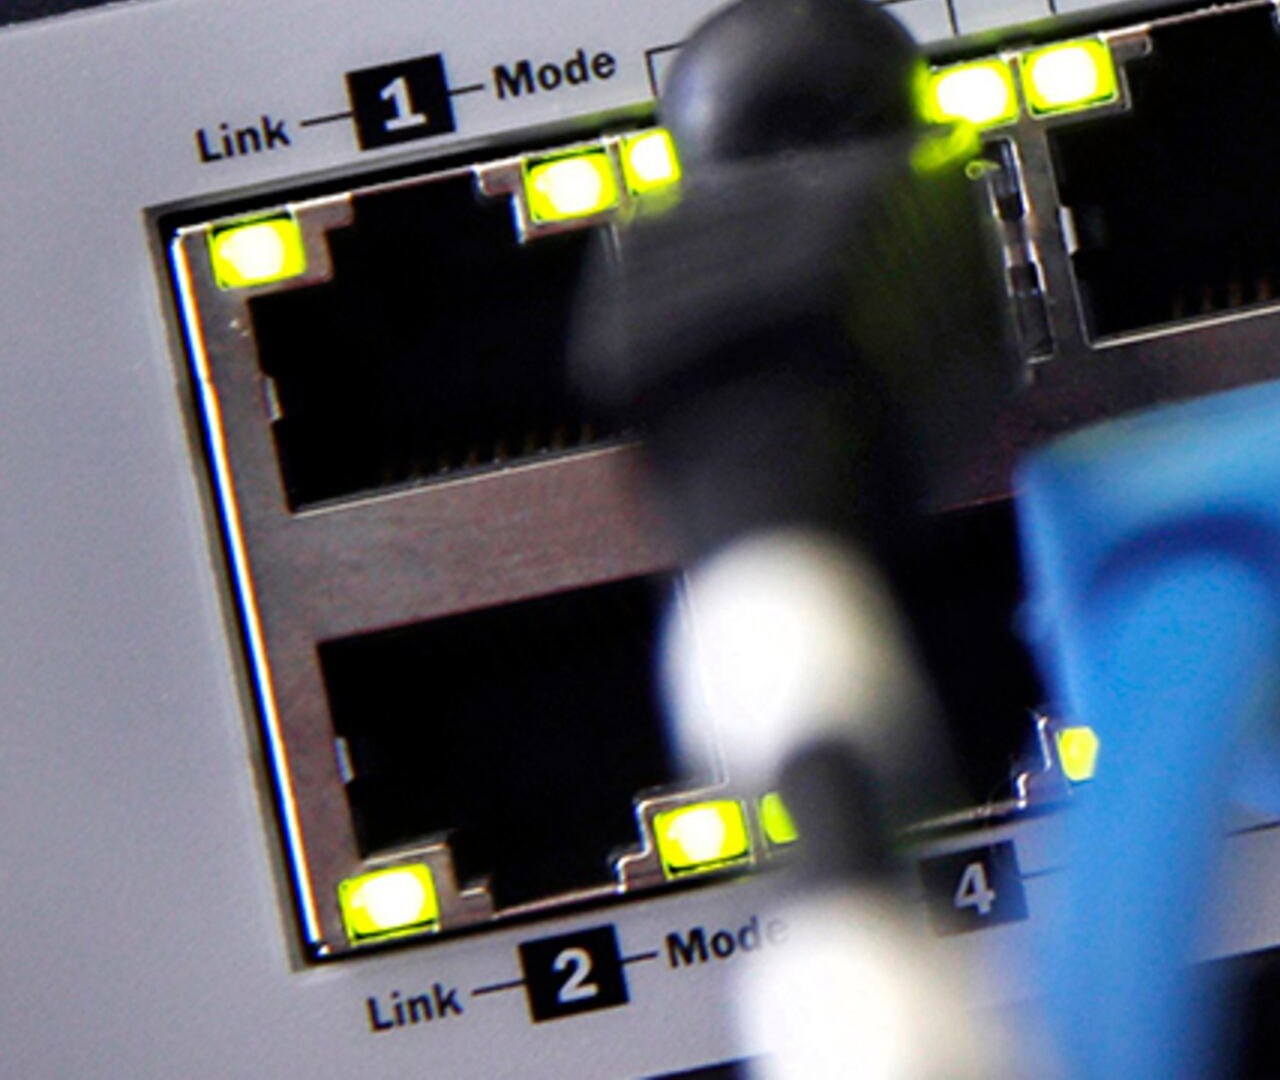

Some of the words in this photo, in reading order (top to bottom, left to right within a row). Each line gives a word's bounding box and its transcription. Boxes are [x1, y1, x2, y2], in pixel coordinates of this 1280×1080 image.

[194, 115, 291, 164] Link
[380, 76, 428, 131] 1
[493, 48, 617, 100] Mode
[953, 861, 998, 916] 4
[366, 983, 463, 1032] Link
[553, 947, 599, 1002] 2
[665, 914, 790, 969] Mode
